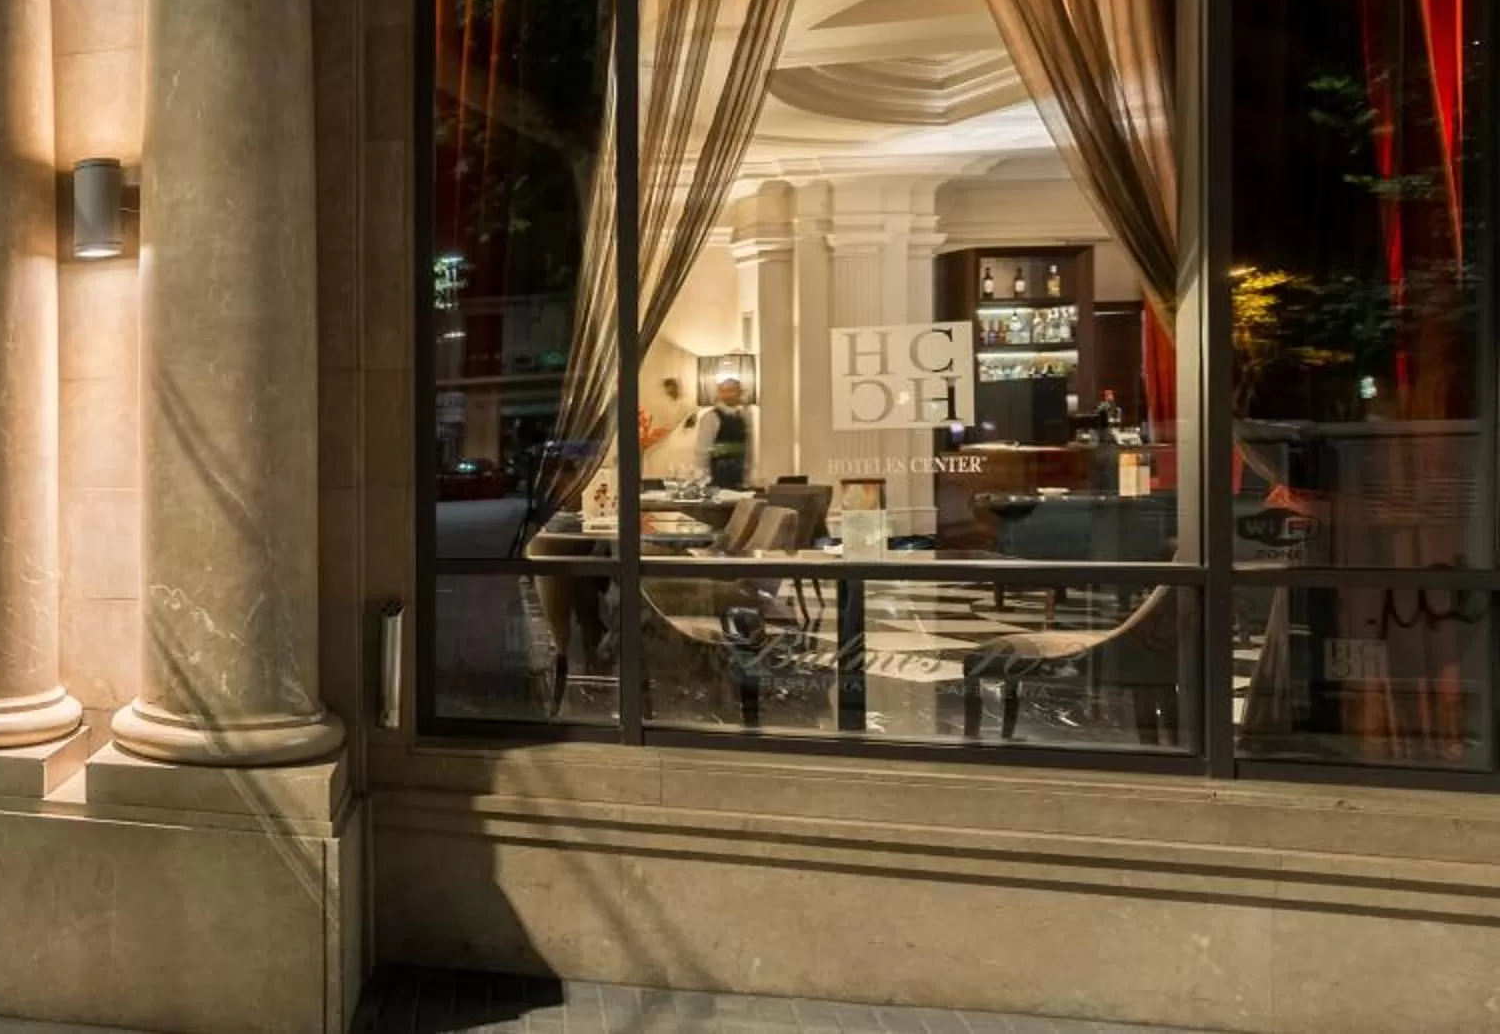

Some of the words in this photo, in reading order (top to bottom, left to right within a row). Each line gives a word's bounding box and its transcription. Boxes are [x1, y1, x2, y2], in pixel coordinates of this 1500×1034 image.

[841, 327, 953, 378] HC
[828, 456, 907, 475] HOTELES
[910, 454, 983, 474] CENTER
